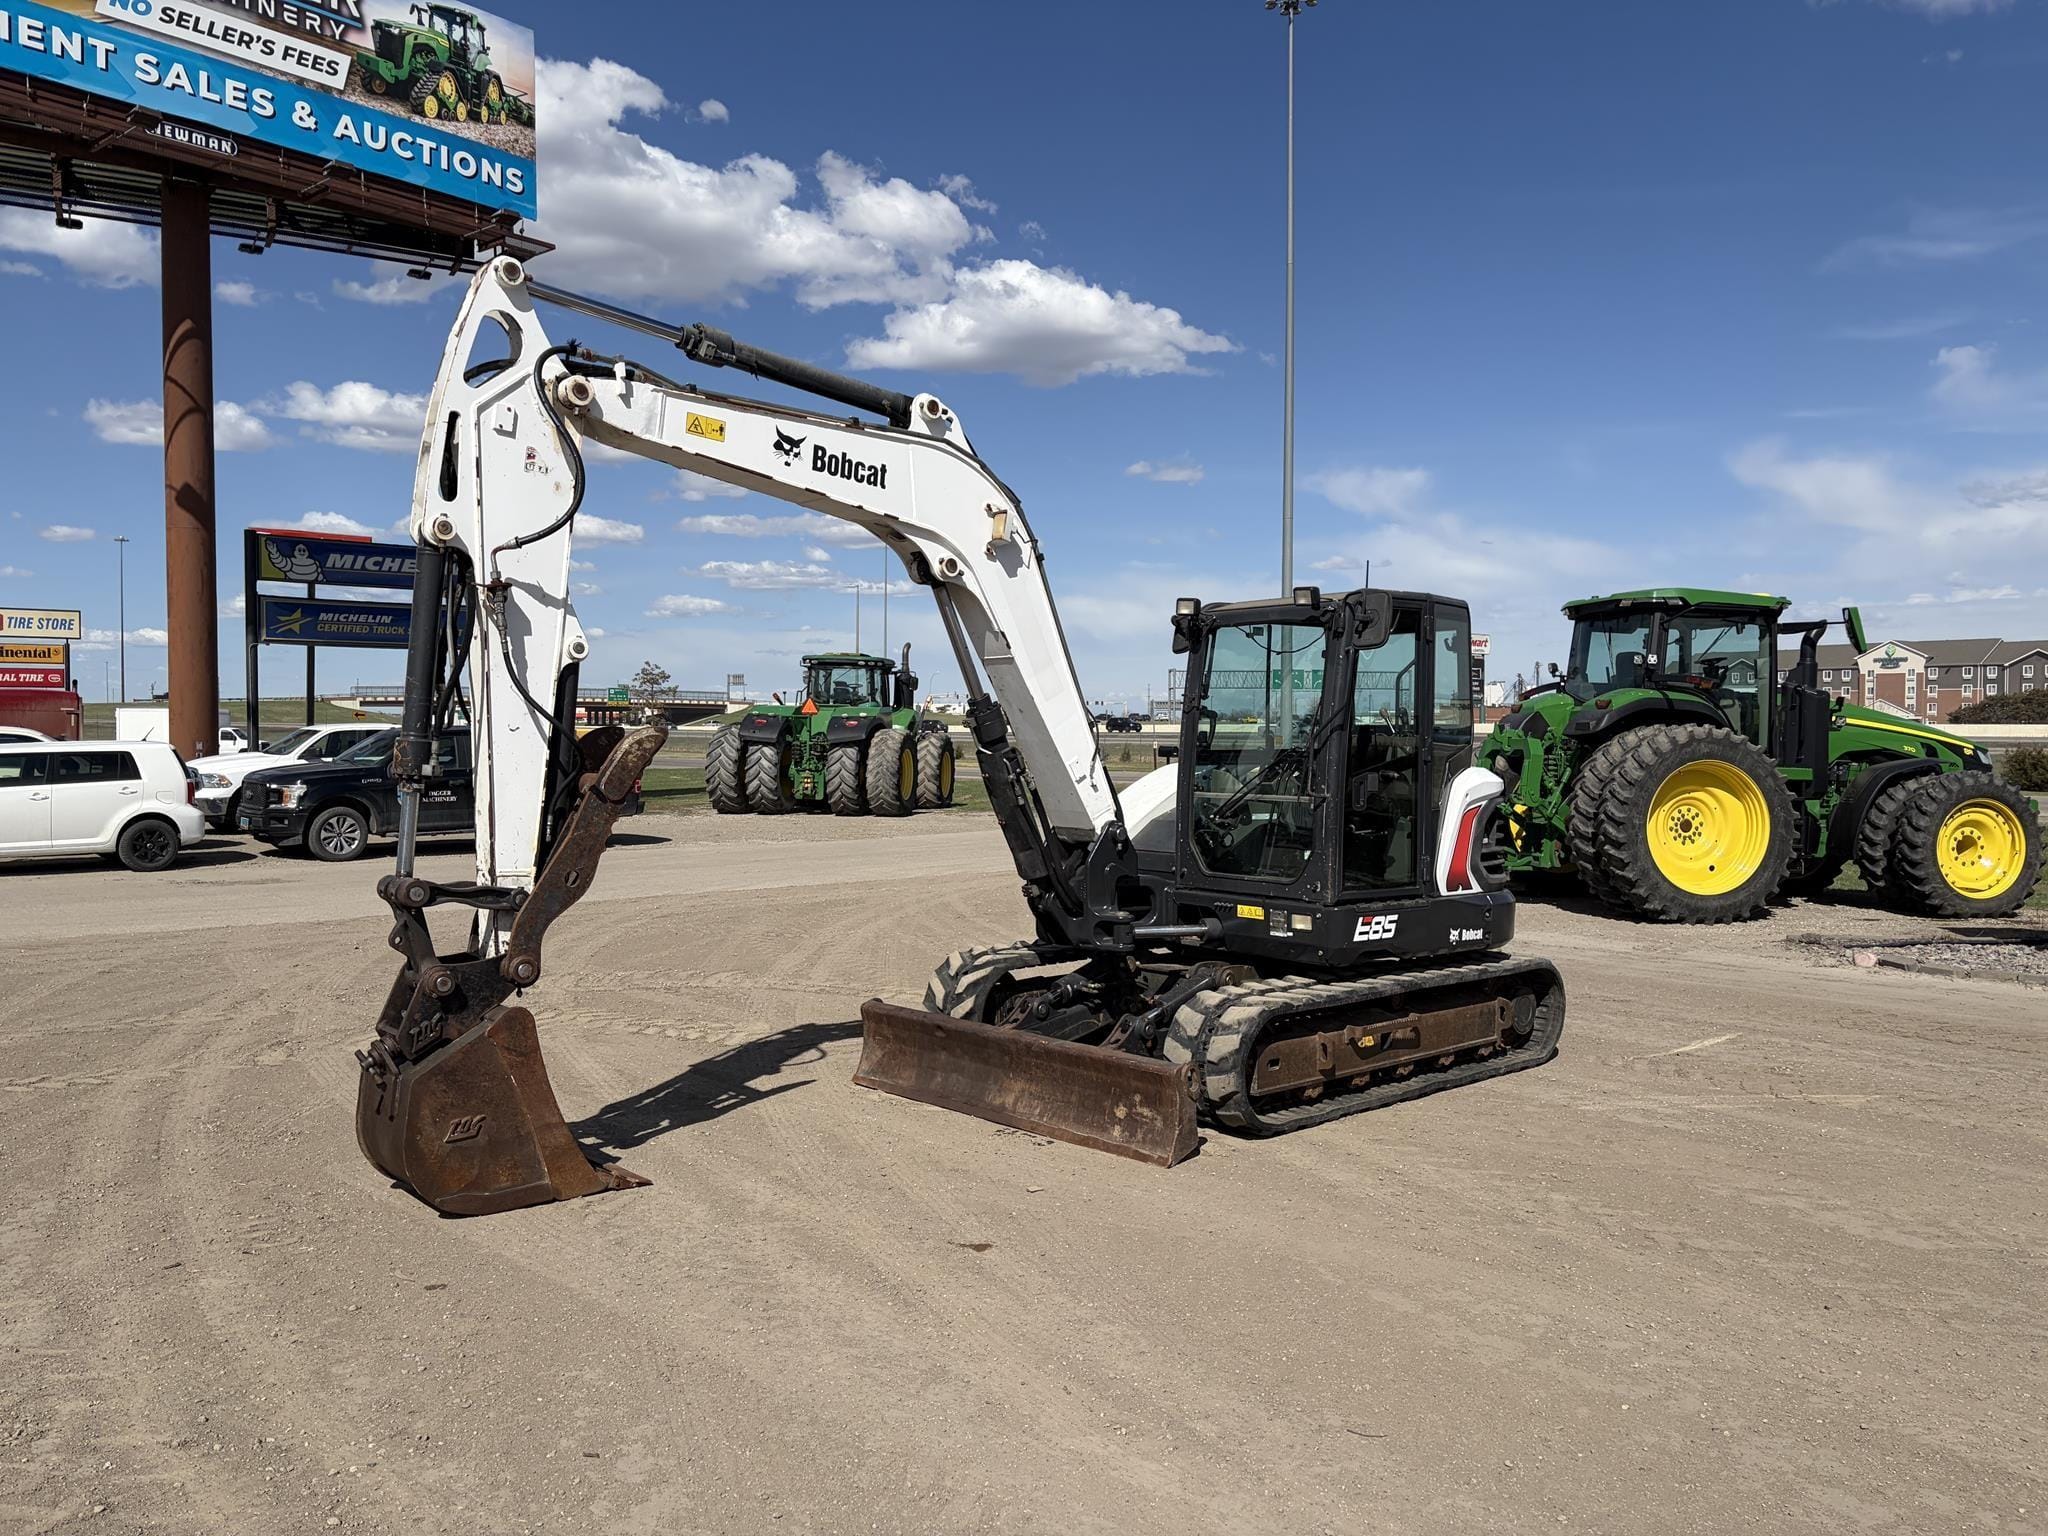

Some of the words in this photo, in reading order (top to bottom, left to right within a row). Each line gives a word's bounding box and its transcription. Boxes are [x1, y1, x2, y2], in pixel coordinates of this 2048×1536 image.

[158, 6, 276, 56] SELLER'S
[281, 45, 340, 76] FEES
[134, 53, 275, 117] SALES
[292, 101, 317, 130] &
[333, 114, 525, 193] AUCTIONS
[811, 444, 888, 489] Bobcat
[7, 616, 34, 629] TIRE
[37, 617, 75, 631] STORE
[318, 612, 393, 624] MICHELIN
[317, 624, 370, 634] CERTIFIED
[373, 625, 405, 636] TRUCK
[19, 674, 44, 682] TIRE
[1353, 914, 1399, 942] E85
[1461, 928, 1483, 942] Bobcat
